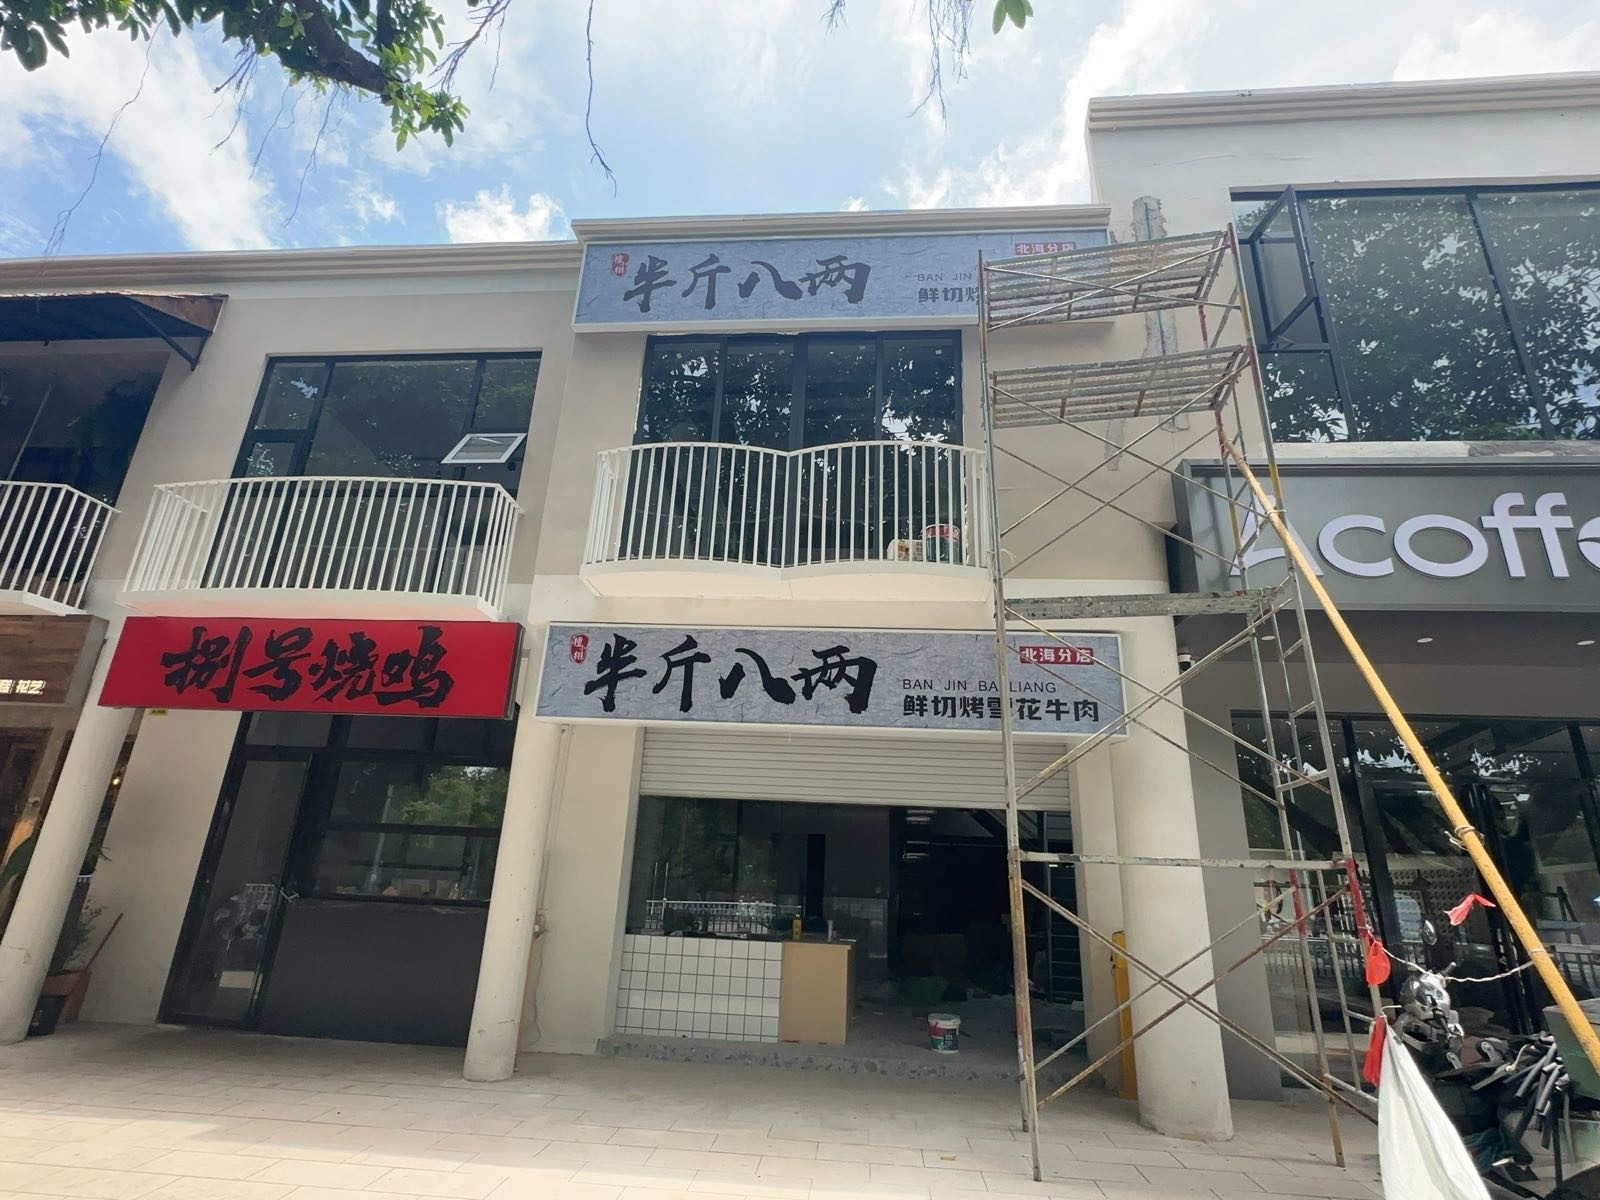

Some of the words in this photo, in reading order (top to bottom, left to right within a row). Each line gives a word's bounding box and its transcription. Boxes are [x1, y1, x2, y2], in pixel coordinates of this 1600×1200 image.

[623, 253, 871, 312] 半斤八两
[917, 272, 943, 282] BAN
[953, 272, 972, 281] JIN
[1229, 492, 1600, 578] Acoff
[584, 633, 877, 714] 半斤八两
[1020, 647, 1091, 663] 北海分店
[903, 679, 934, 691] BAN
[944, 680, 967, 691] JIN
[1009, 681, 1057, 694] LIANG
